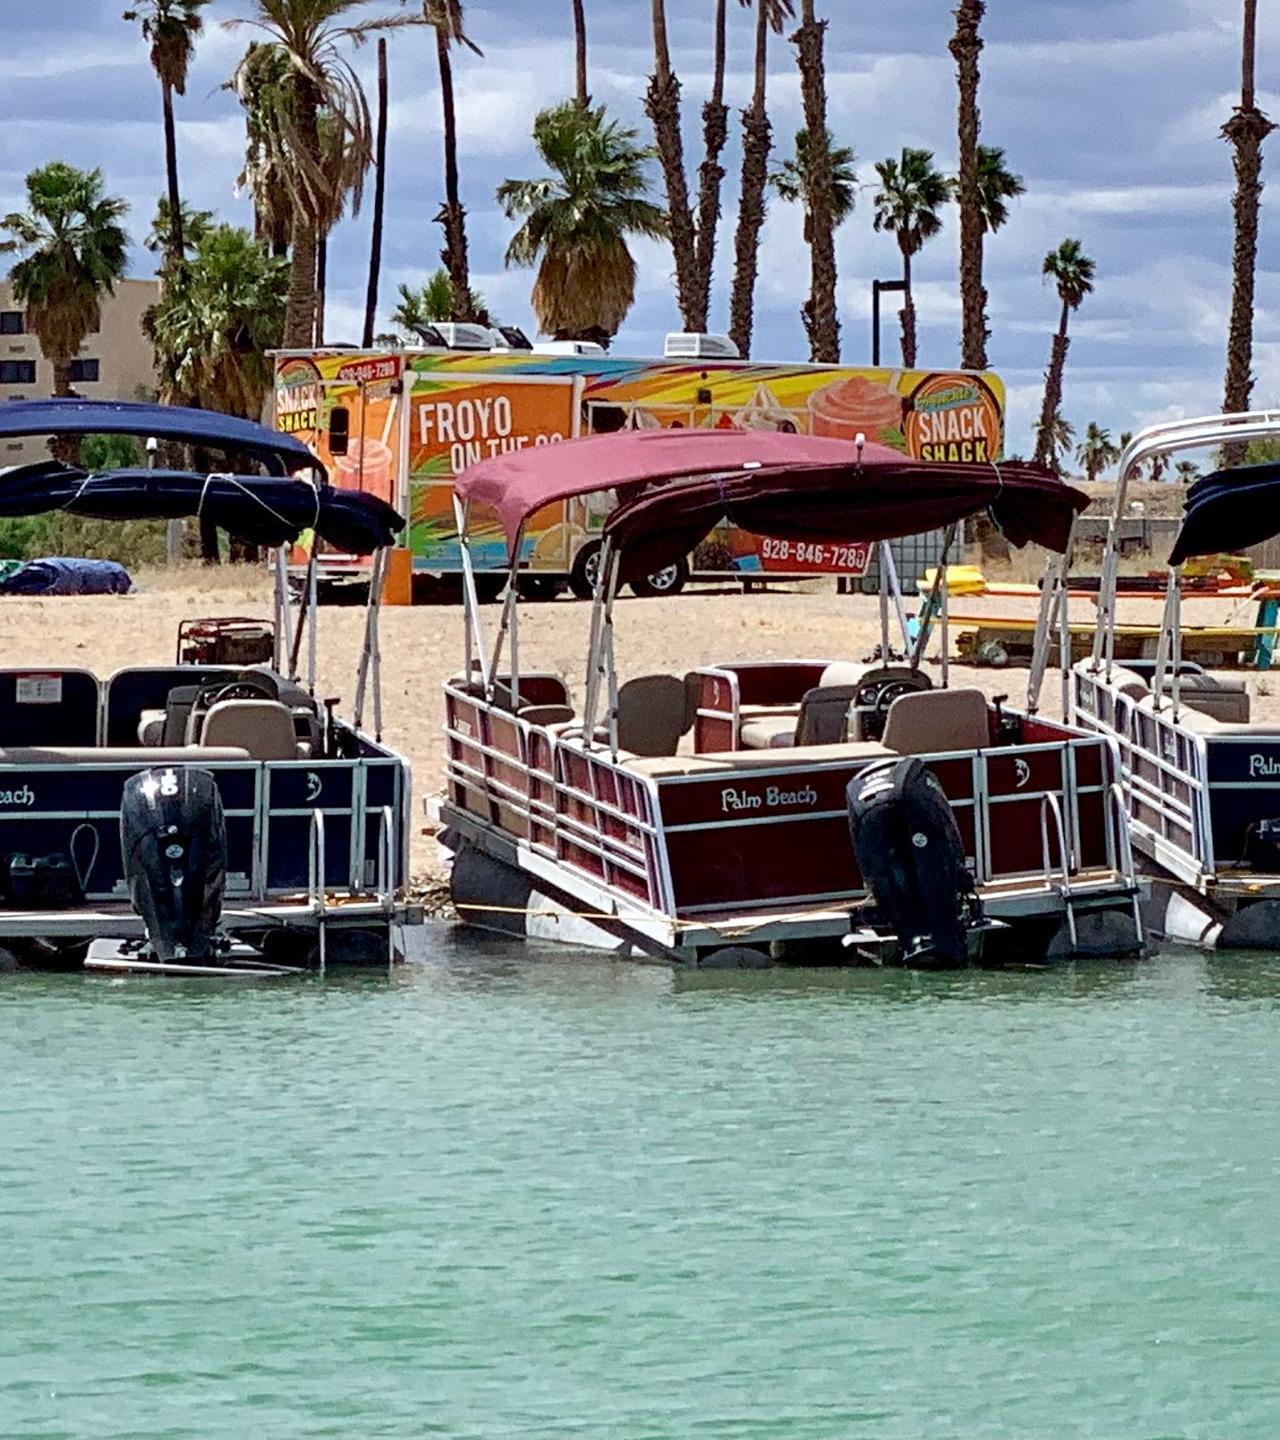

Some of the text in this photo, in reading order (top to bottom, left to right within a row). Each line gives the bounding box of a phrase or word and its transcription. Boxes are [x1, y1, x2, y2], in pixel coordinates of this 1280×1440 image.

[276, 385, 317, 414] SNACK
[279, 410, 317, 433] SHACK
[419, 396, 513, 445] FROYO
[919, 405, 988, 446] SNACK
[450, 440, 482, 474] ON
[921, 440, 988, 463] SHACK
[761, 539, 866, 569] 928-846-7280
[0, 784, 35, 806] each
[721, 785, 818, 812] Palm Beach
